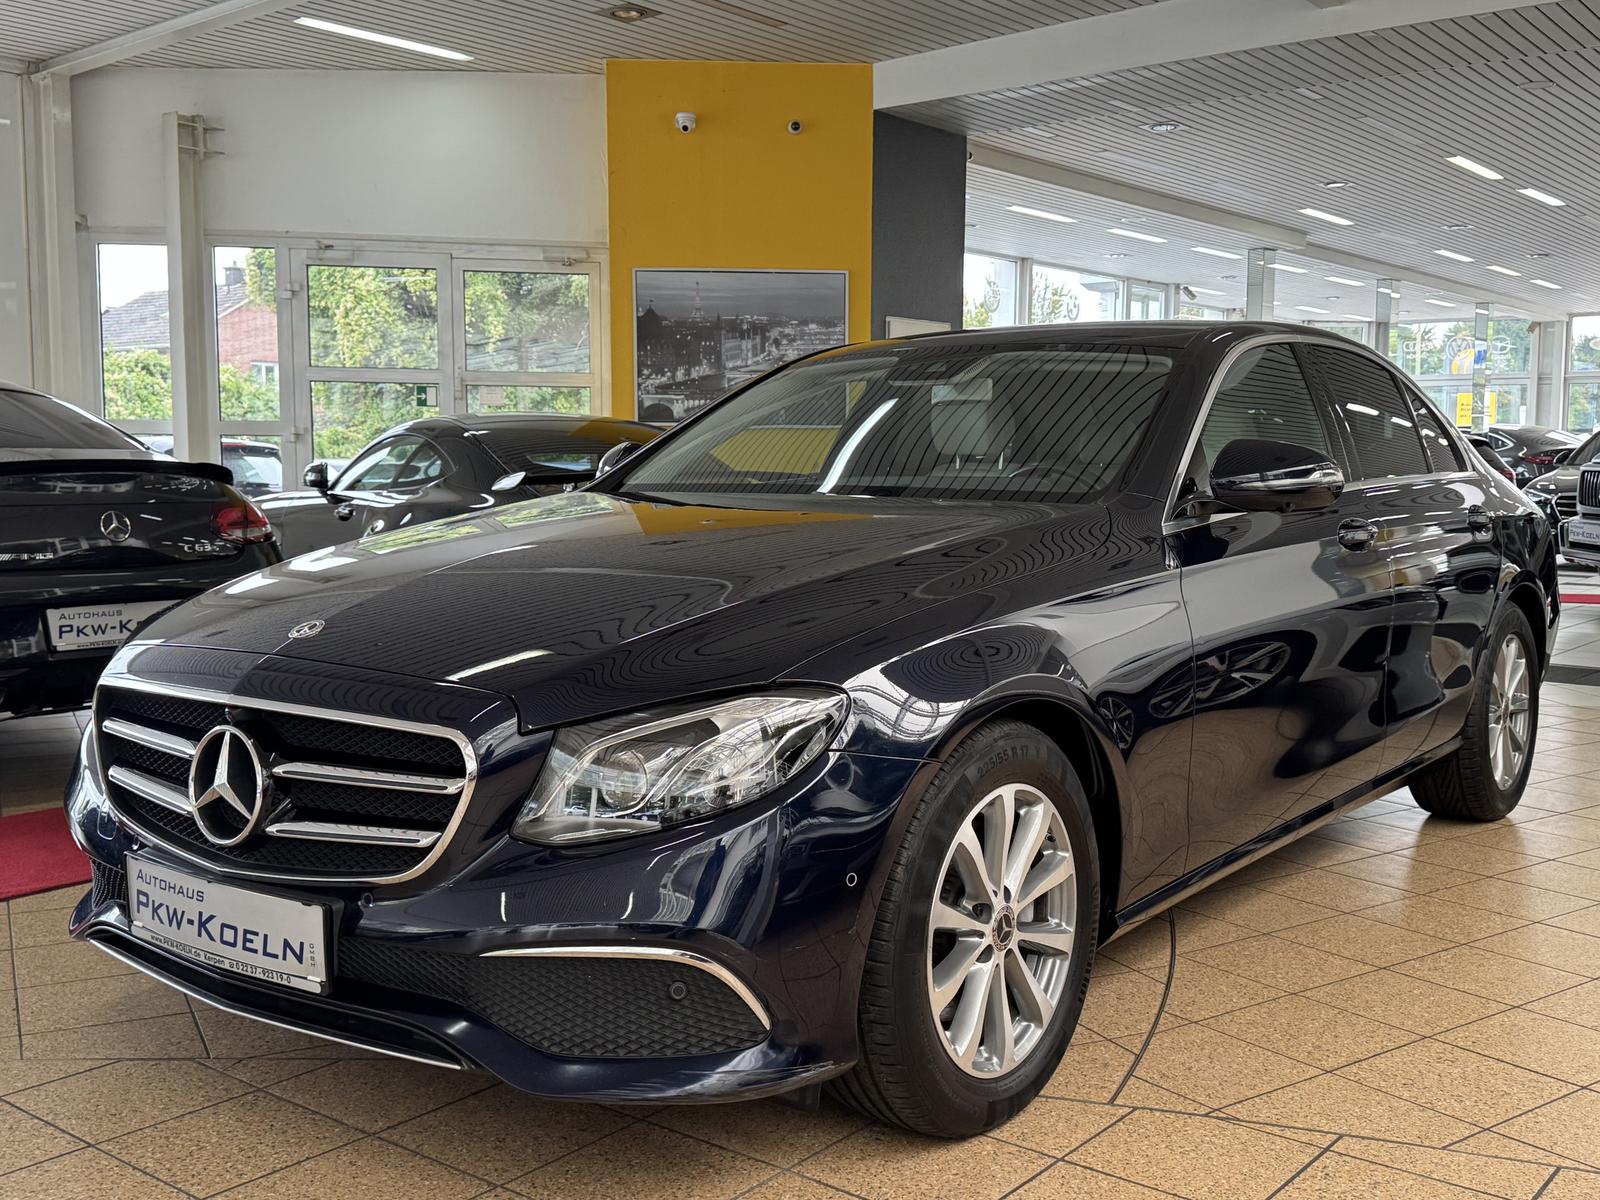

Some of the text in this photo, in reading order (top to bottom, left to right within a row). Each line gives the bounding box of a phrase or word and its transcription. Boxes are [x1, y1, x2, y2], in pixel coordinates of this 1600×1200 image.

[58, 619, 143, 640] PKW-K
[59, 609, 123, 621] AUTOHAUS
[977, 749, 1010, 778] 225/55
[136, 868, 205, 903] AUTOHAUS
[136, 888, 305, 965] PKW-KOELN
[150, 934, 202, 959] www.PKW-KOELN.de
[203, 950, 226, 967] Kerpen
